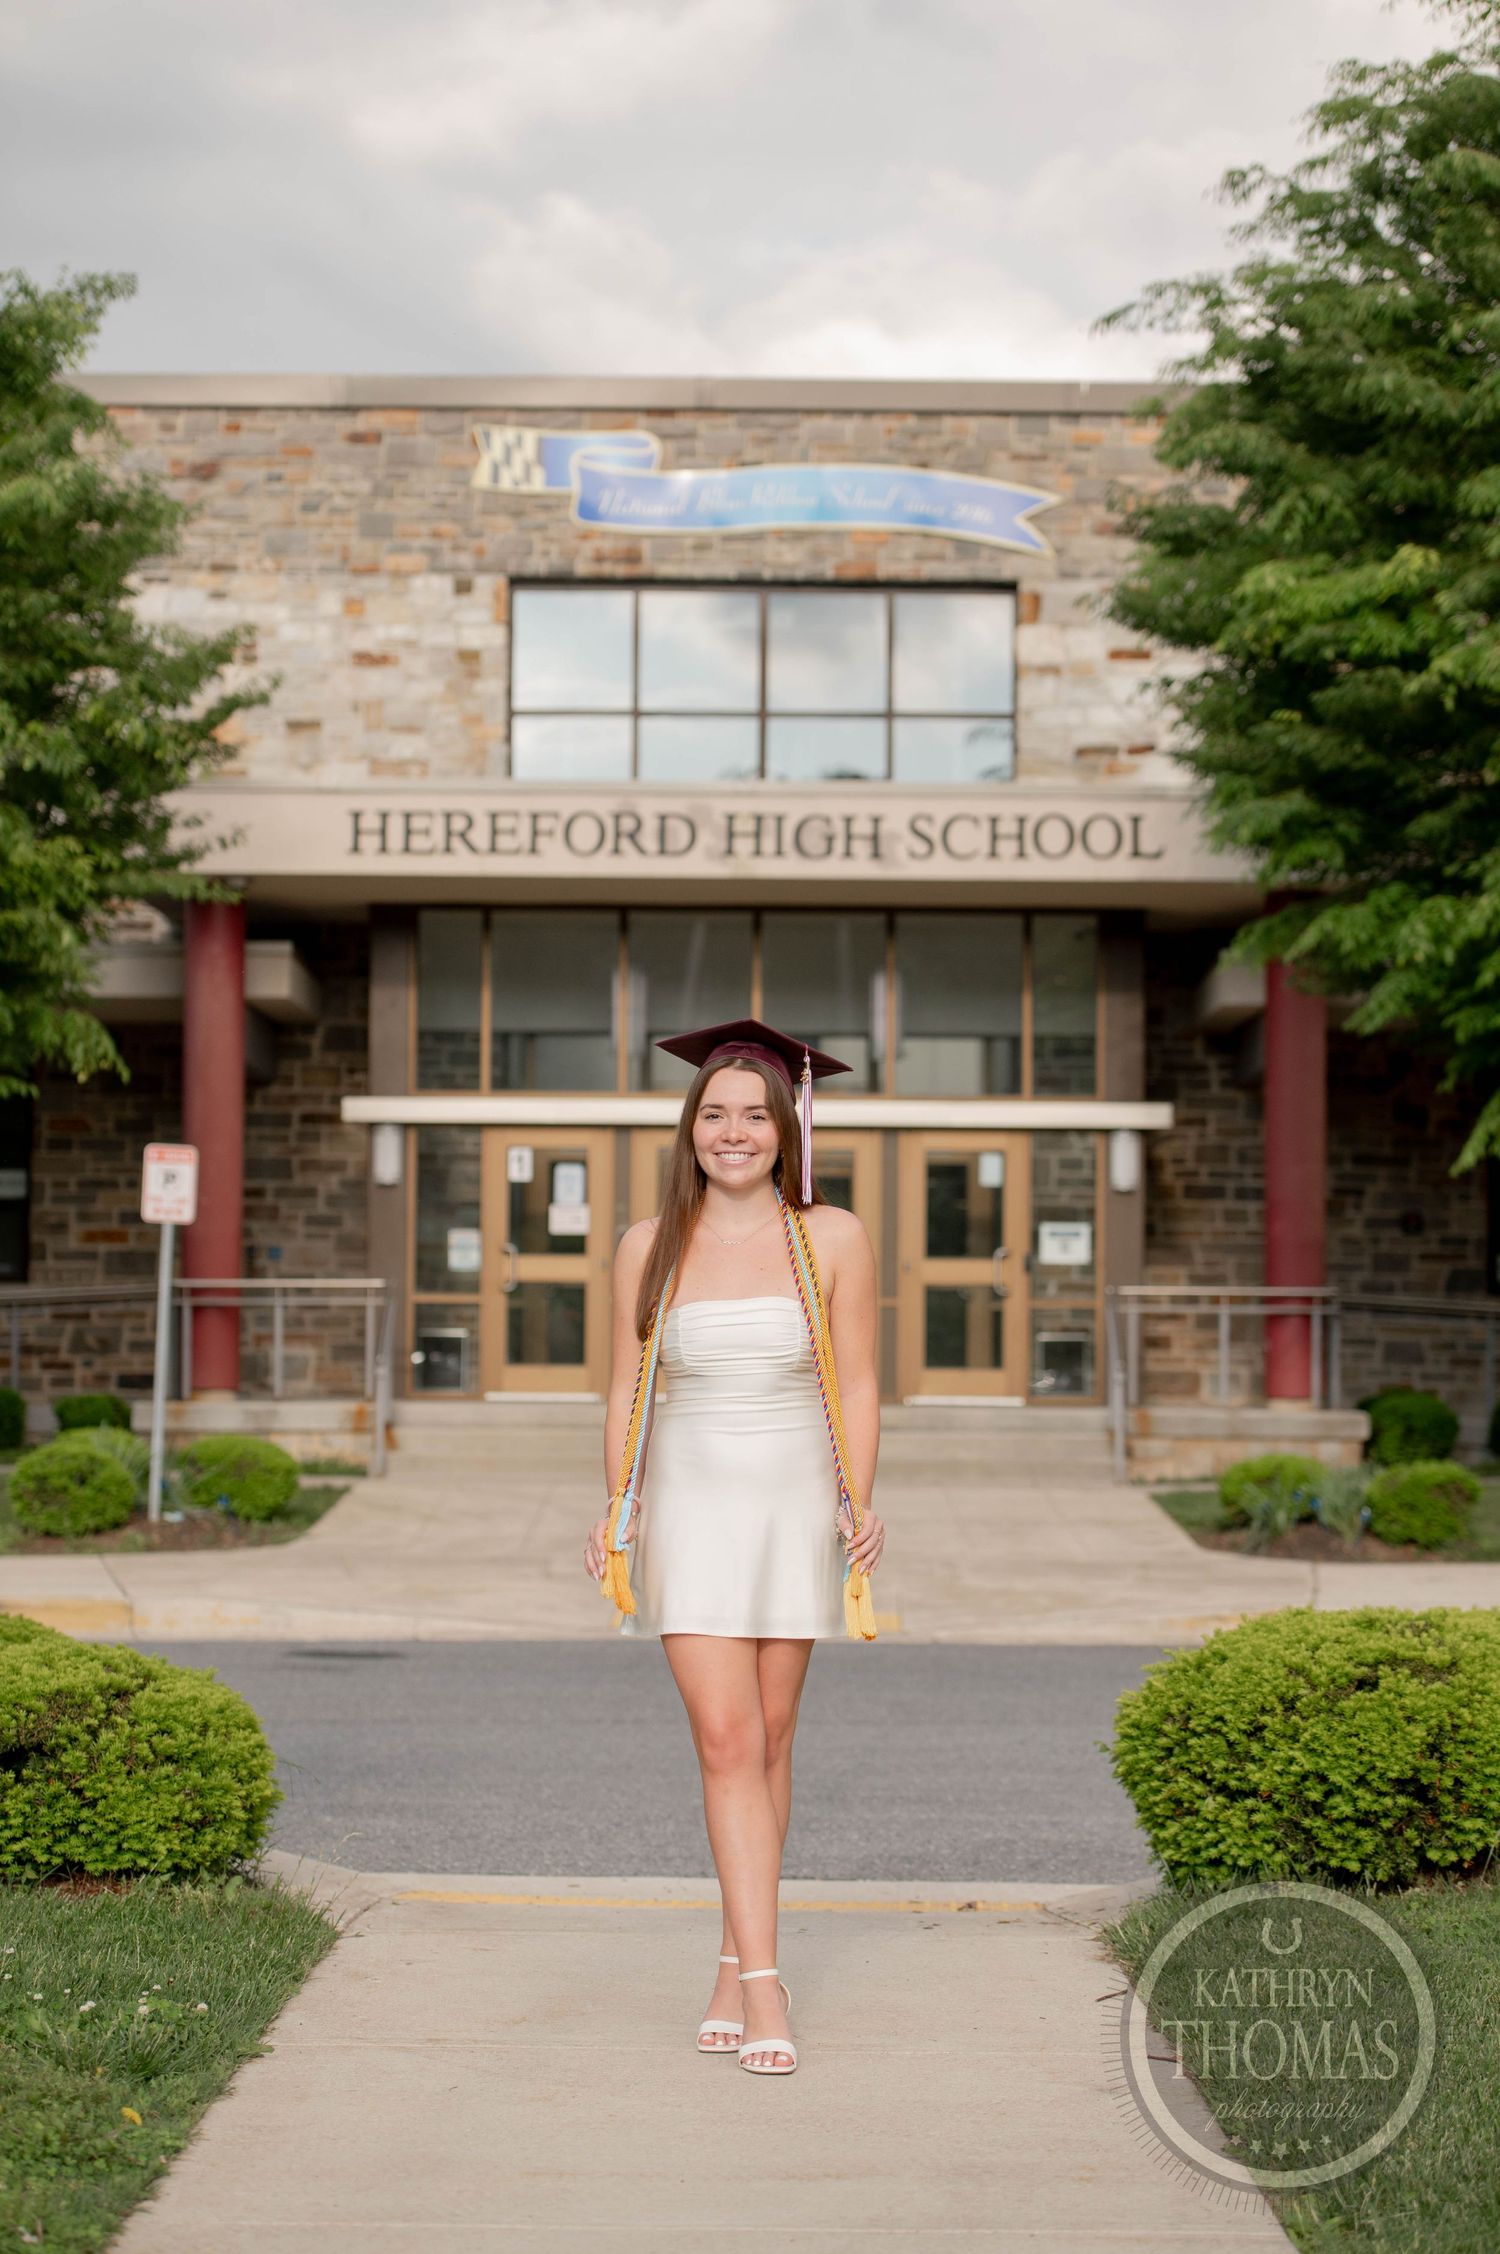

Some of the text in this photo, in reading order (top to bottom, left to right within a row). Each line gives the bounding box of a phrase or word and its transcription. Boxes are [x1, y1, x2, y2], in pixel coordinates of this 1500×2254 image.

[347, 810, 1166, 861] HEREFORD HIGH SCHOOL
